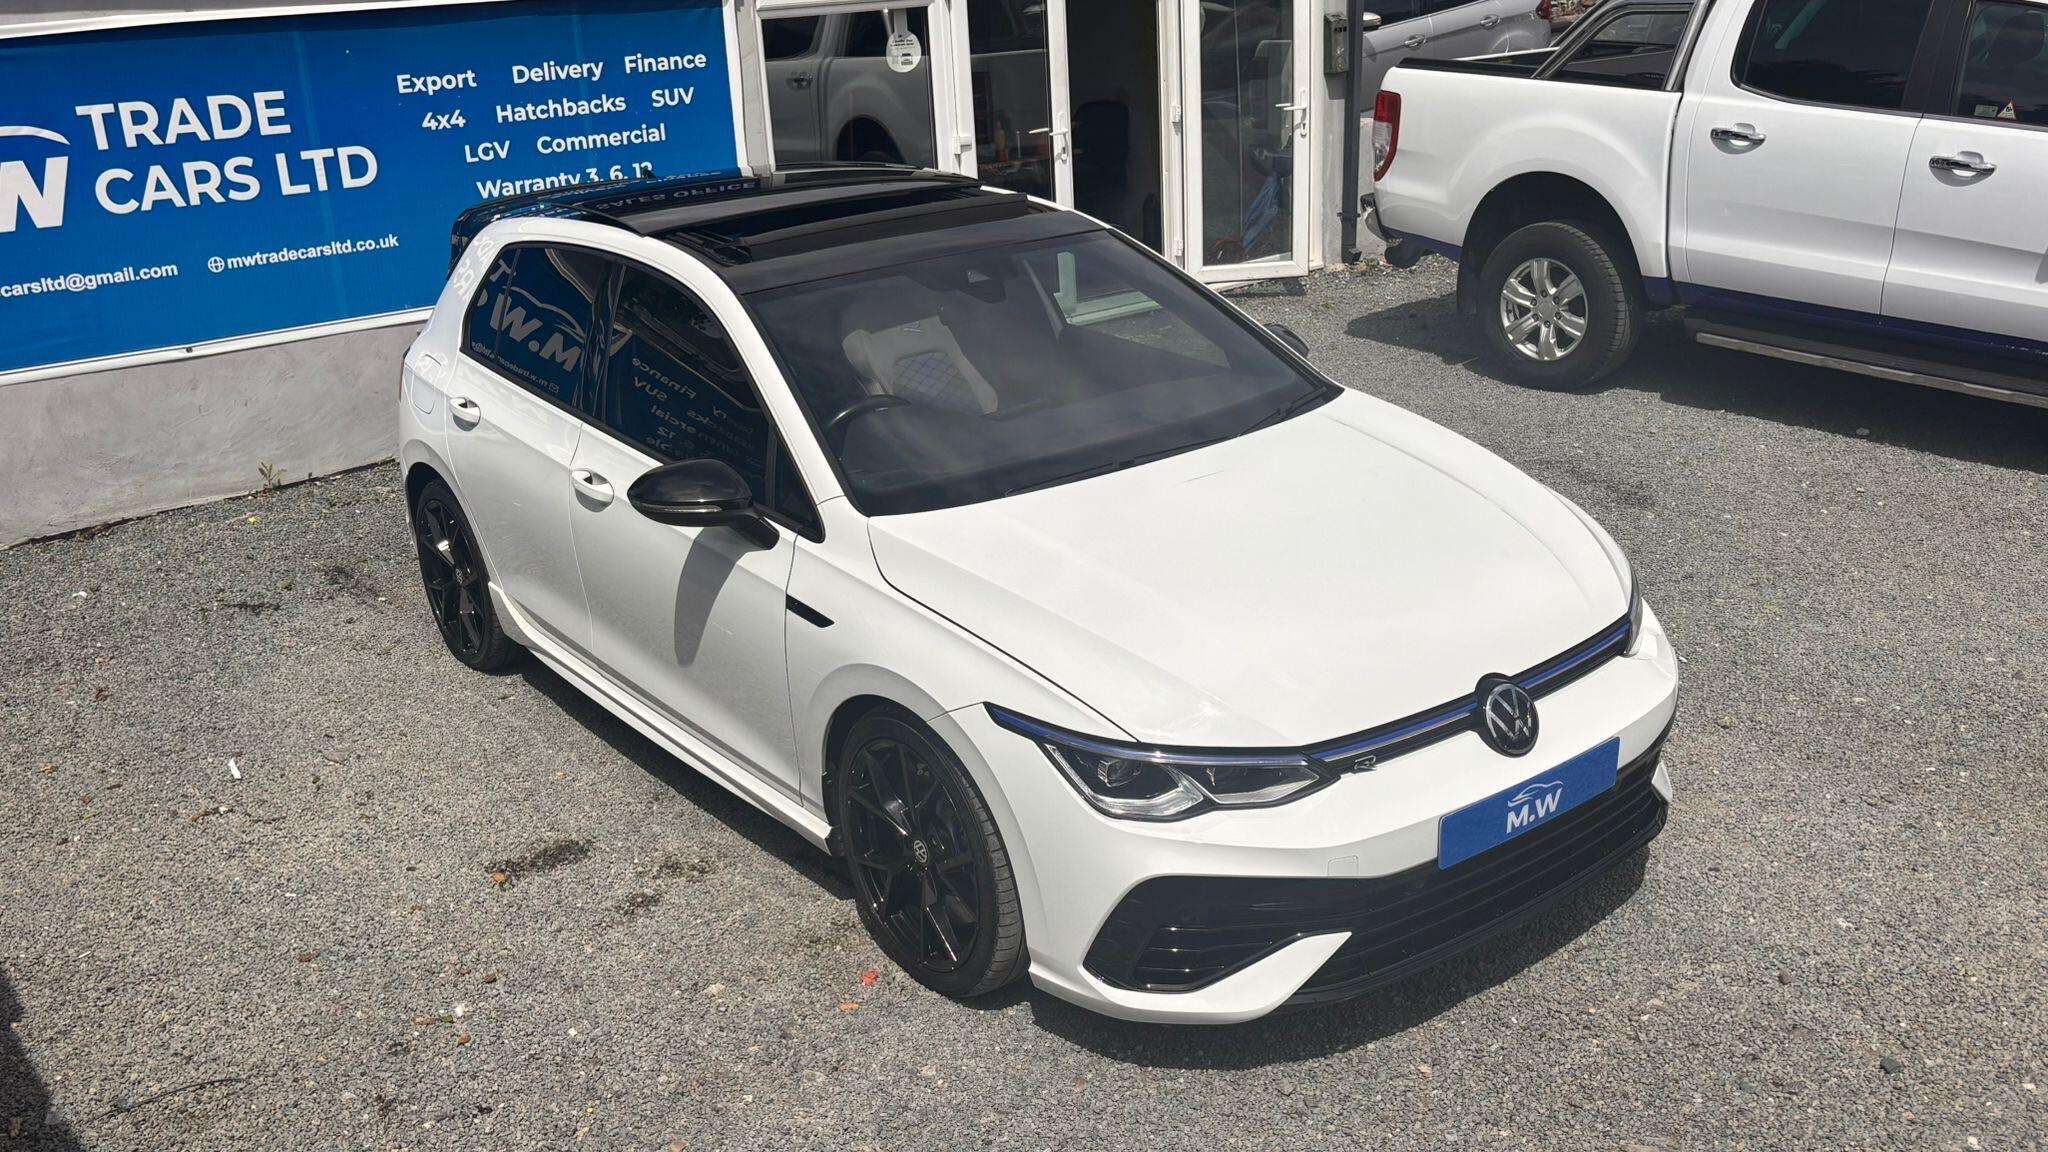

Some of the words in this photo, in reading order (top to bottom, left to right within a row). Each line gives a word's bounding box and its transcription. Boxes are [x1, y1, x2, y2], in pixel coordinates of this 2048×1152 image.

[397, 70, 477, 96] Export
[512, 61, 604, 85] Delivery
[624, 53, 707, 73] Finance
[75, 90, 291, 150] TRADE
[421, 109, 466, 131] 4x4
[496, 94, 627, 124] Hatchbacks
[651, 87, 694, 108] SUV
[464, 141, 510, 163] LGV
[536, 123, 666, 155] Commercial
[95, 156, 260, 215] CARS
[275, 145, 378, 196] LTD
[227, 233, 400, 269] mwtradecarsltd.co.uk
[0, 264, 179, 297] carsltd@gmail.com
[1505, 789, 1563, 834] M.W
